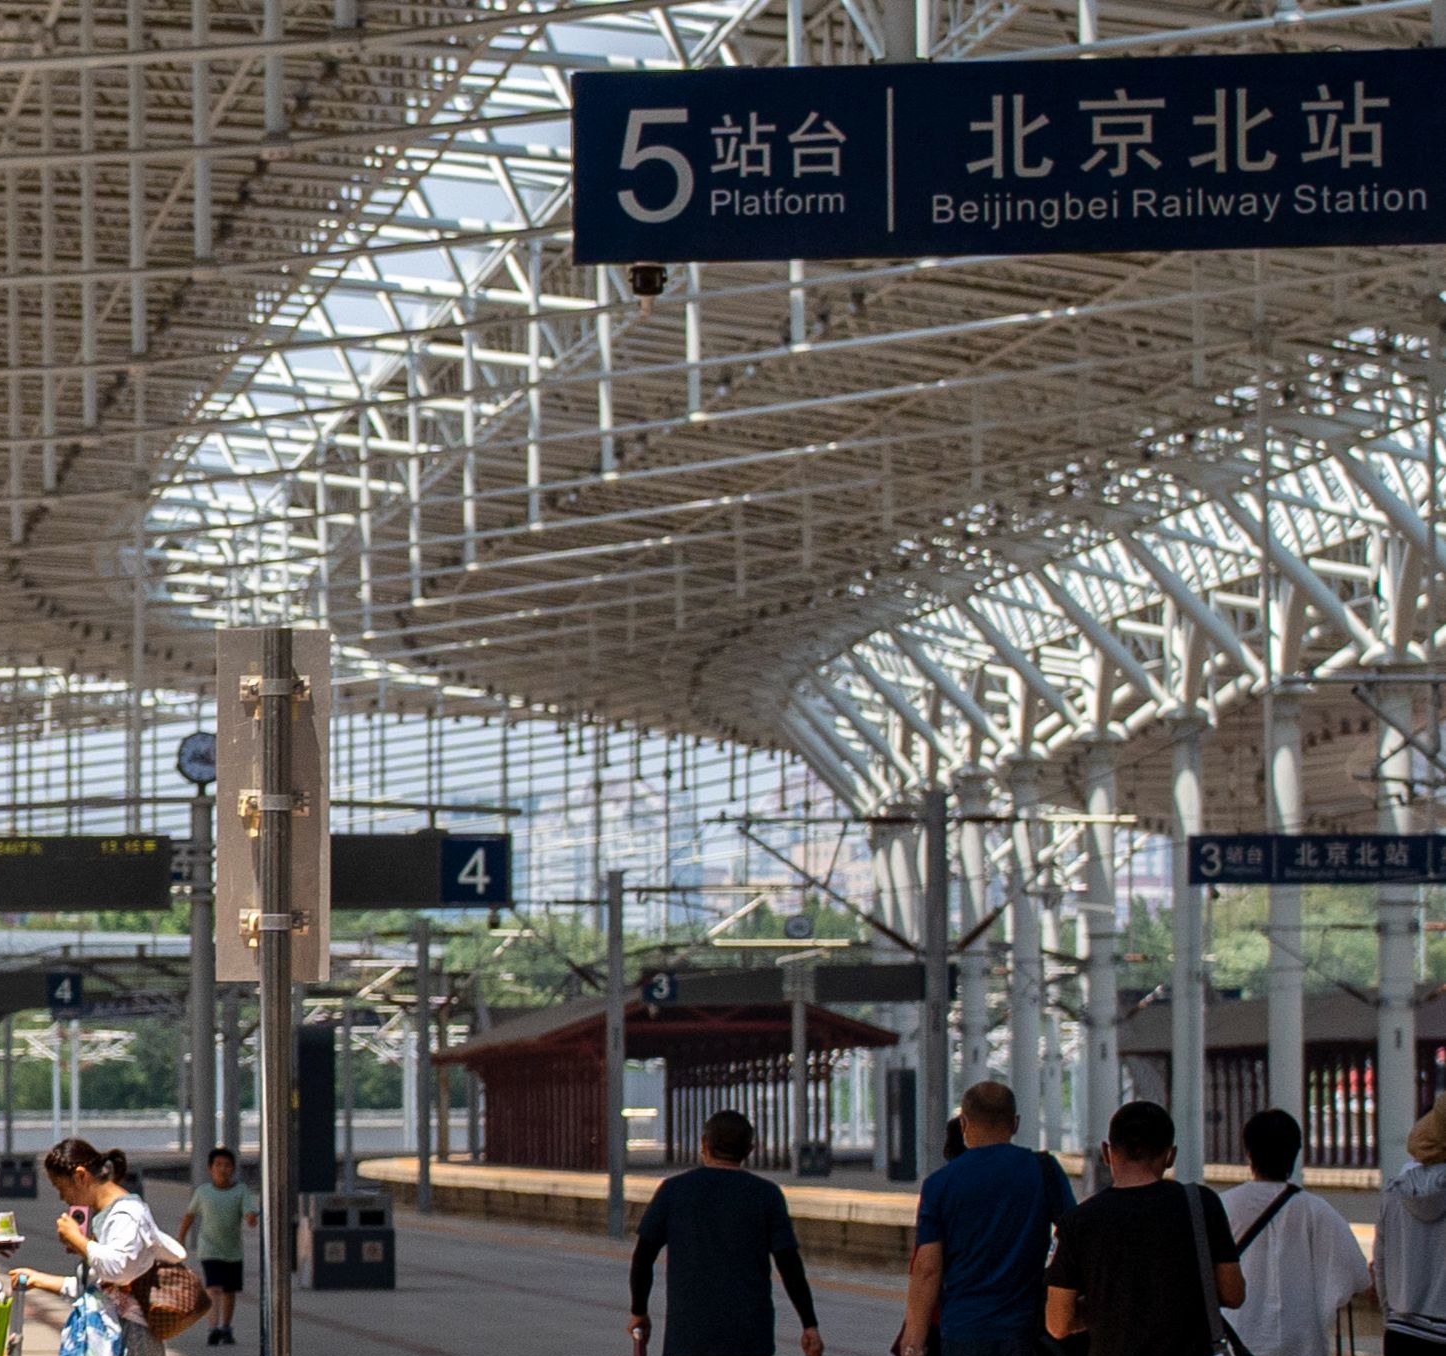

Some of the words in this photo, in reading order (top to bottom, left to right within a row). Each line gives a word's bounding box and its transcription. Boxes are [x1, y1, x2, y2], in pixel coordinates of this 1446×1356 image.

[966, 80, 1390, 179] 北京北站
[617, 108, 694, 224] 5
[710, 111, 847, 178] 站台
[710, 188, 846, 216] Platform
[932, 190, 1119, 230] Beijingbei
[1132, 187, 1281, 223] Railway
[1293, 183, 1428, 214] Station
[457, 847, 491, 894] 4
[1199, 842, 1223, 877] 3
[1294, 841, 1410, 867] 北京北站
[54, 978, 73, 1004] 4
[652, 972, 671, 1000] 3
